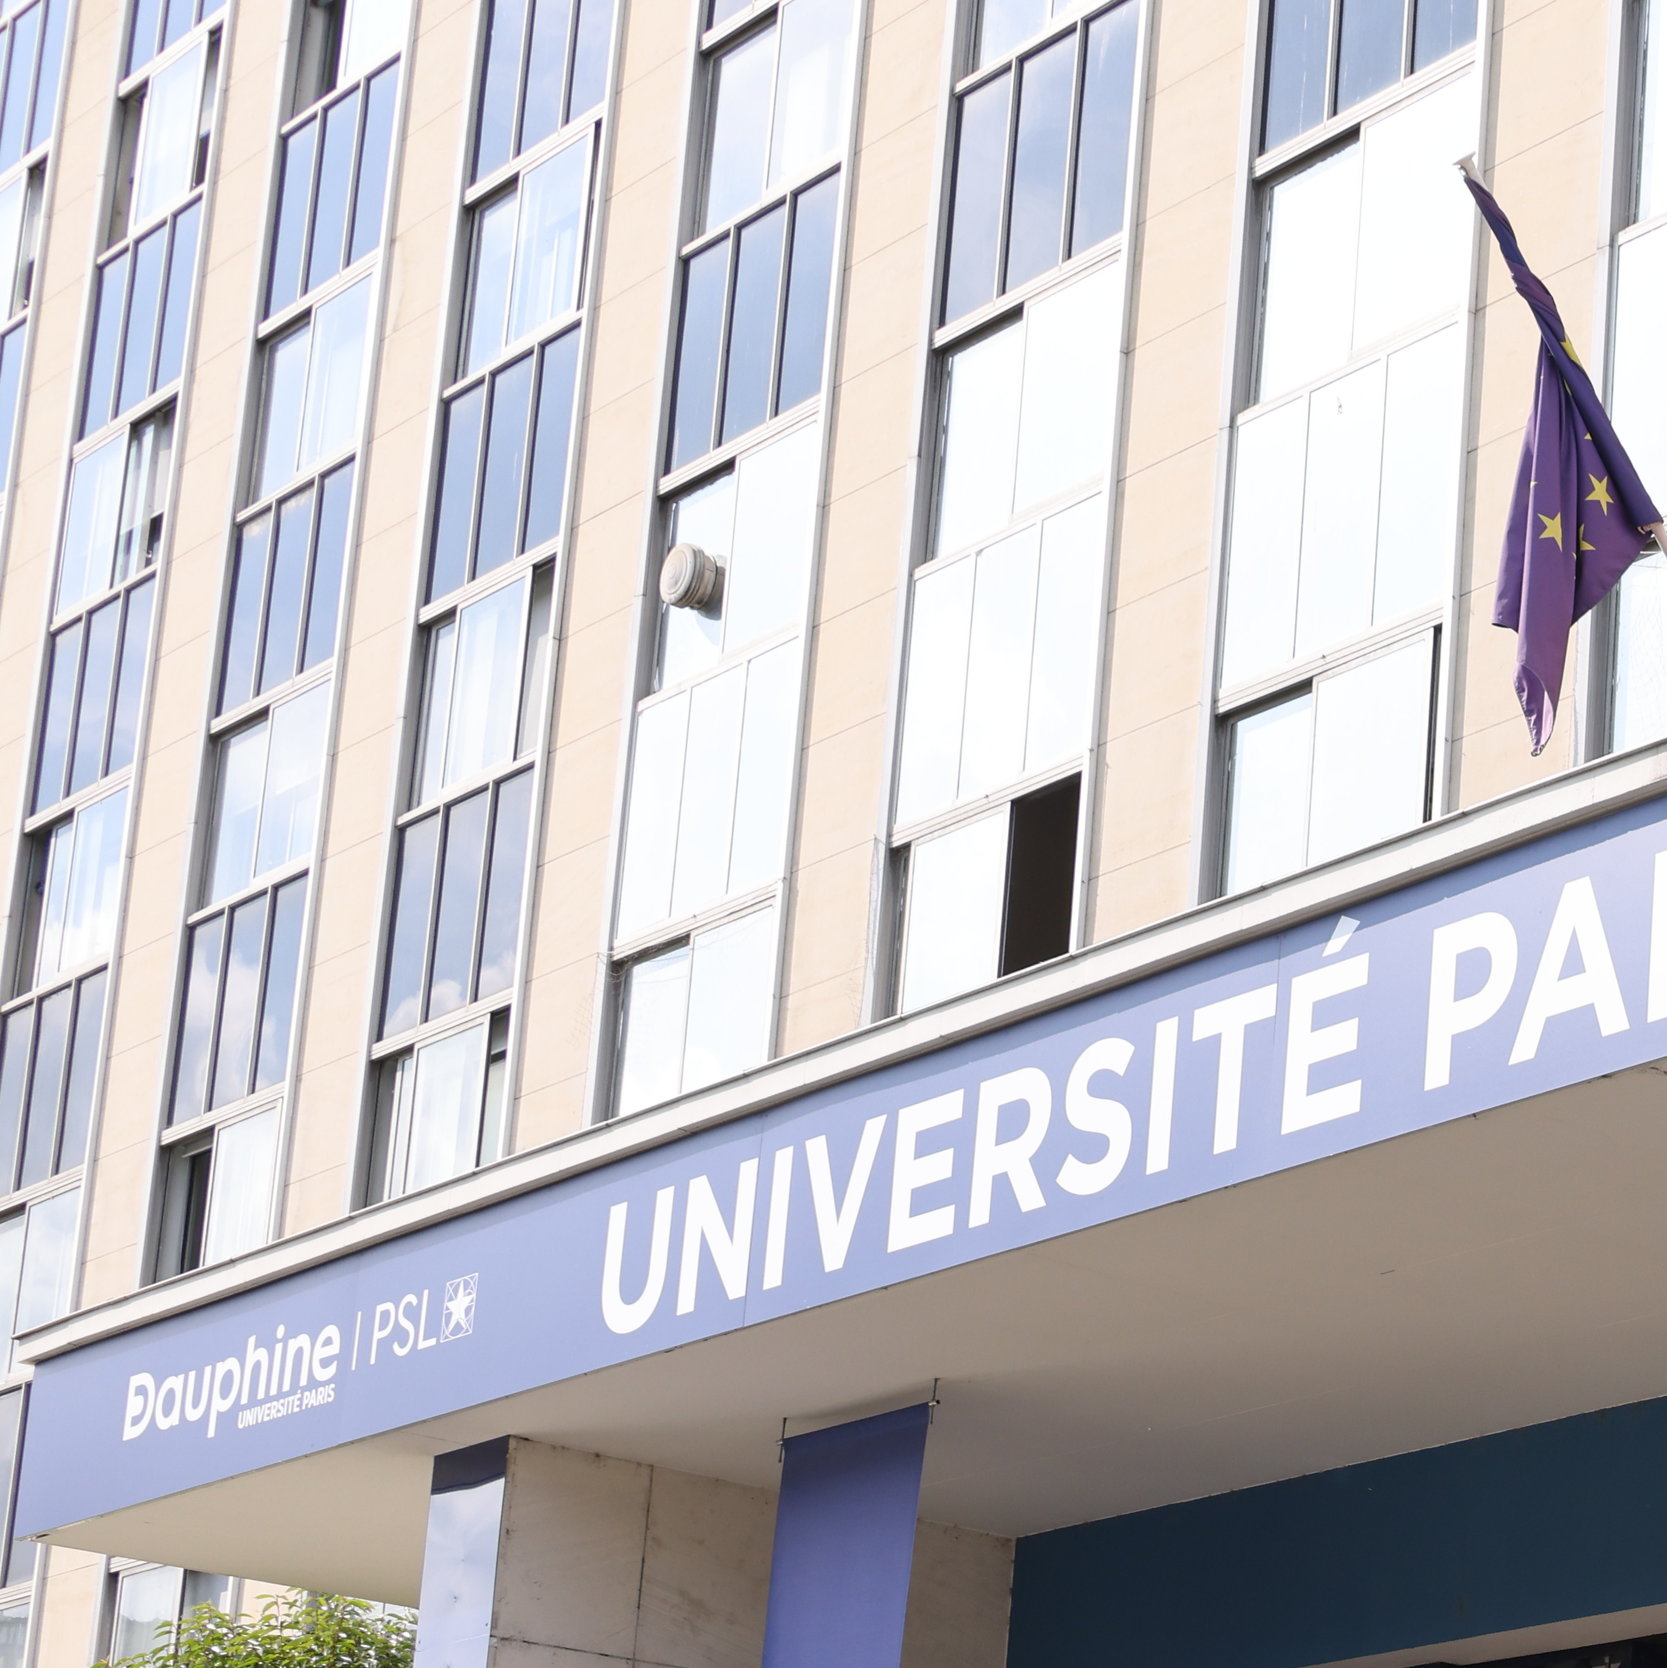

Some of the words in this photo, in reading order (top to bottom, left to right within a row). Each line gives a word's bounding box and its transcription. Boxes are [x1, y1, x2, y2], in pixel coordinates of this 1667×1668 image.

[601, 915, 1371, 1335] UNIVERSITÉ
[121, 1323, 341, 1442] Dauphine
[369, 1288, 437, 1366] PSL
[237, 1389, 303, 1430] UNIVERSITÉ
[301, 1383, 336, 1411] PARIS
